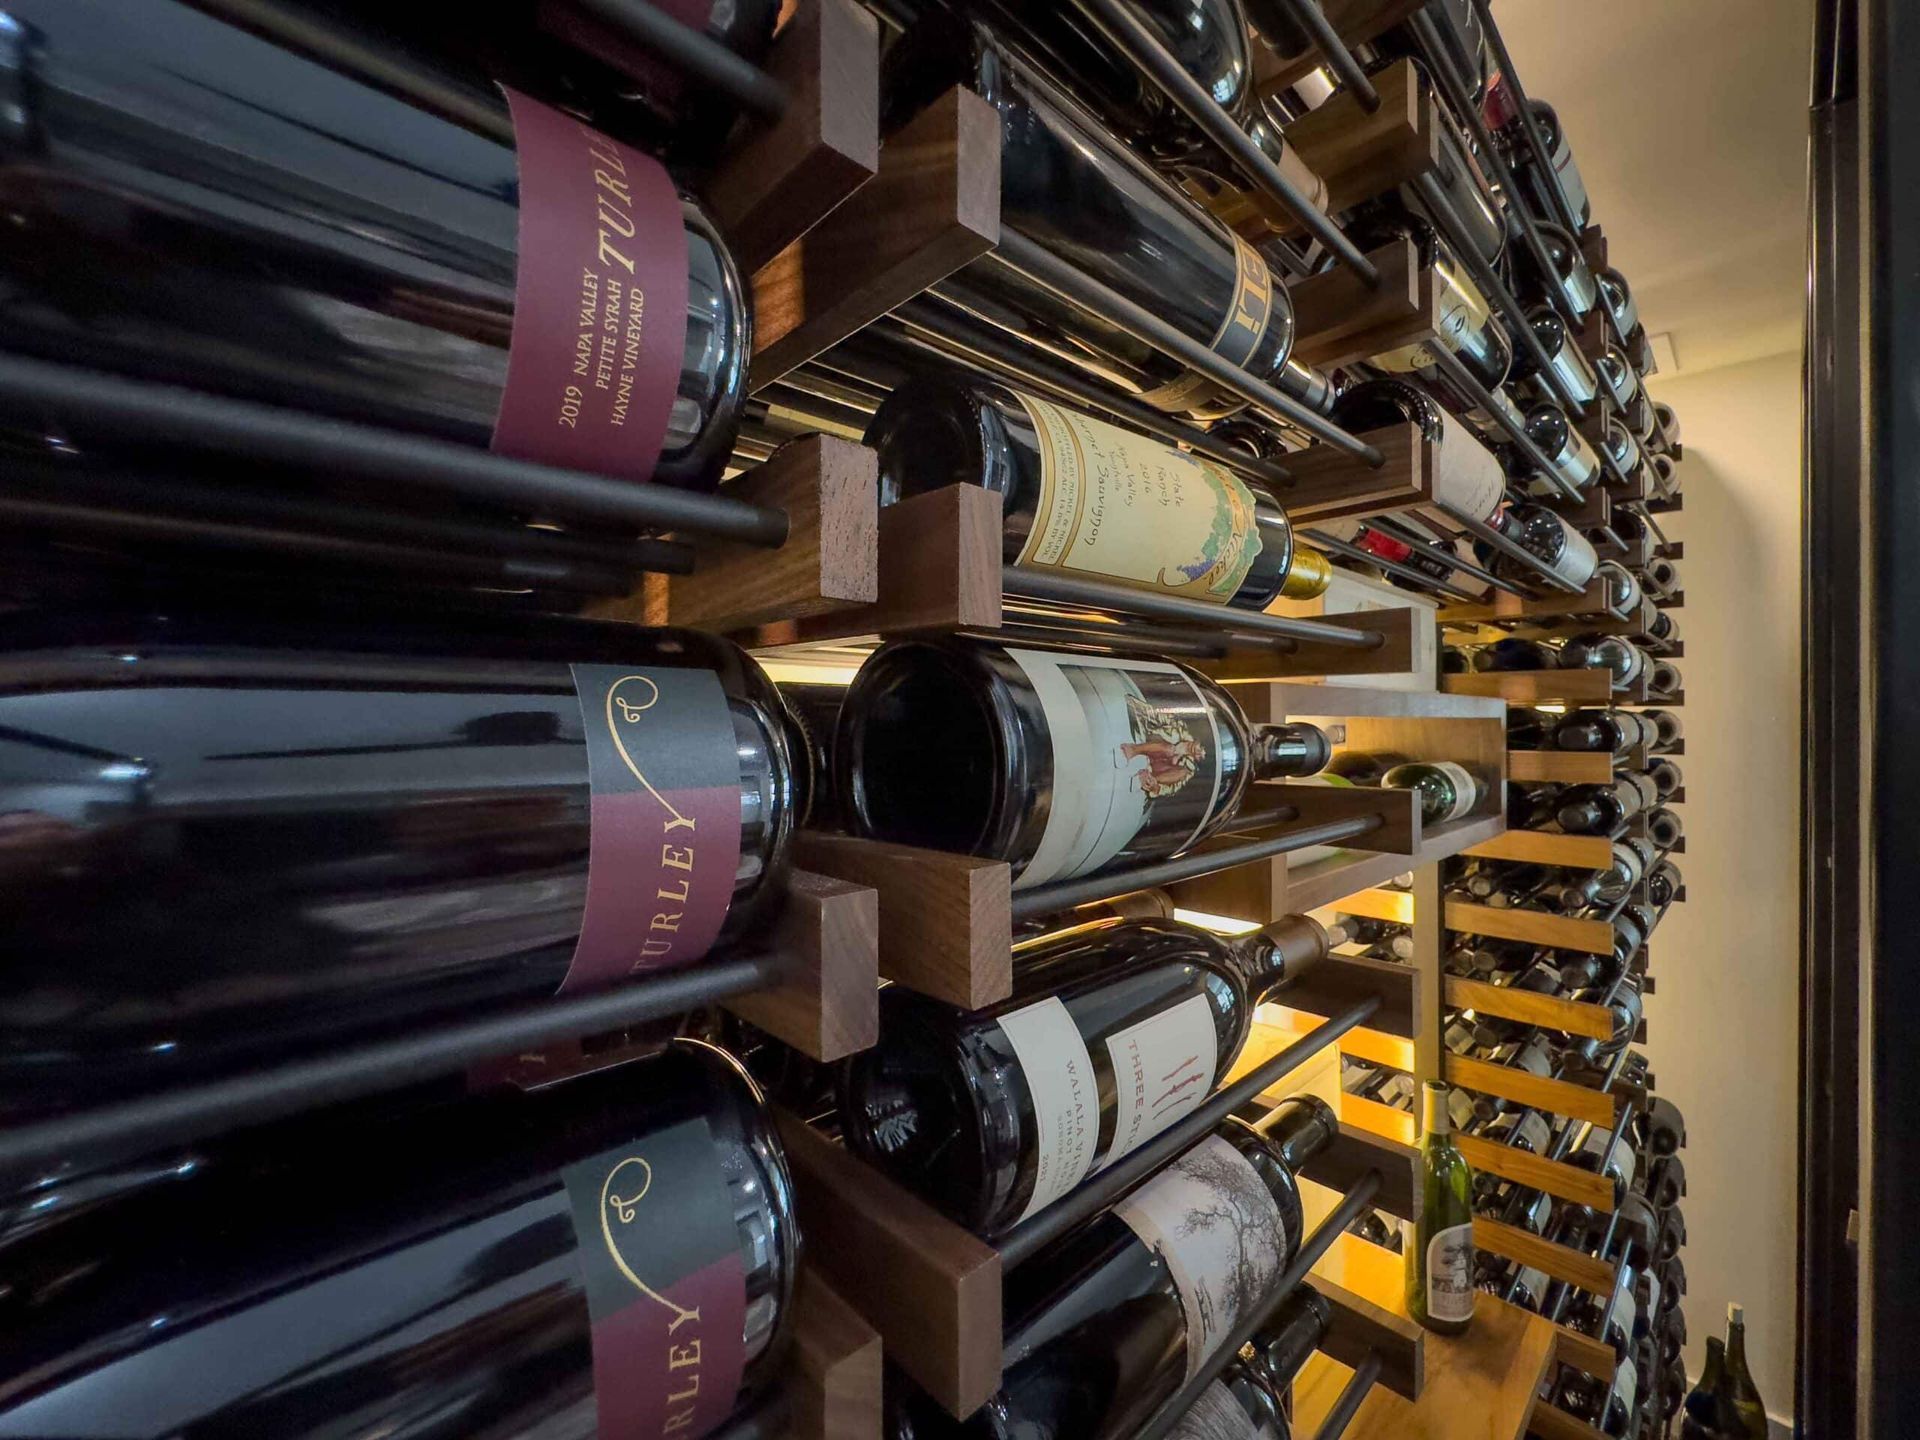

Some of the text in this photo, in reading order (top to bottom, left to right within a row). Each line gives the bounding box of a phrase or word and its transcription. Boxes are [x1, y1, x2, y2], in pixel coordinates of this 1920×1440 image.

[582, 132, 636, 275] TURLE
[558, 267, 599, 429] 2019 NAPA VALLEY
[595, 278, 622, 390] PETITE SYRAH
[610, 288, 645, 426] HAYNE VINEYARD
[1084, 464, 1110, 546] Sauvignon
[1123, 473, 1137, 507] Valley
[1065, 1110, 1074, 1154] PINOT
[1066, 1059, 1084, 1137] WALALA
[1121, 1039, 1145, 1155] THREE STIC
